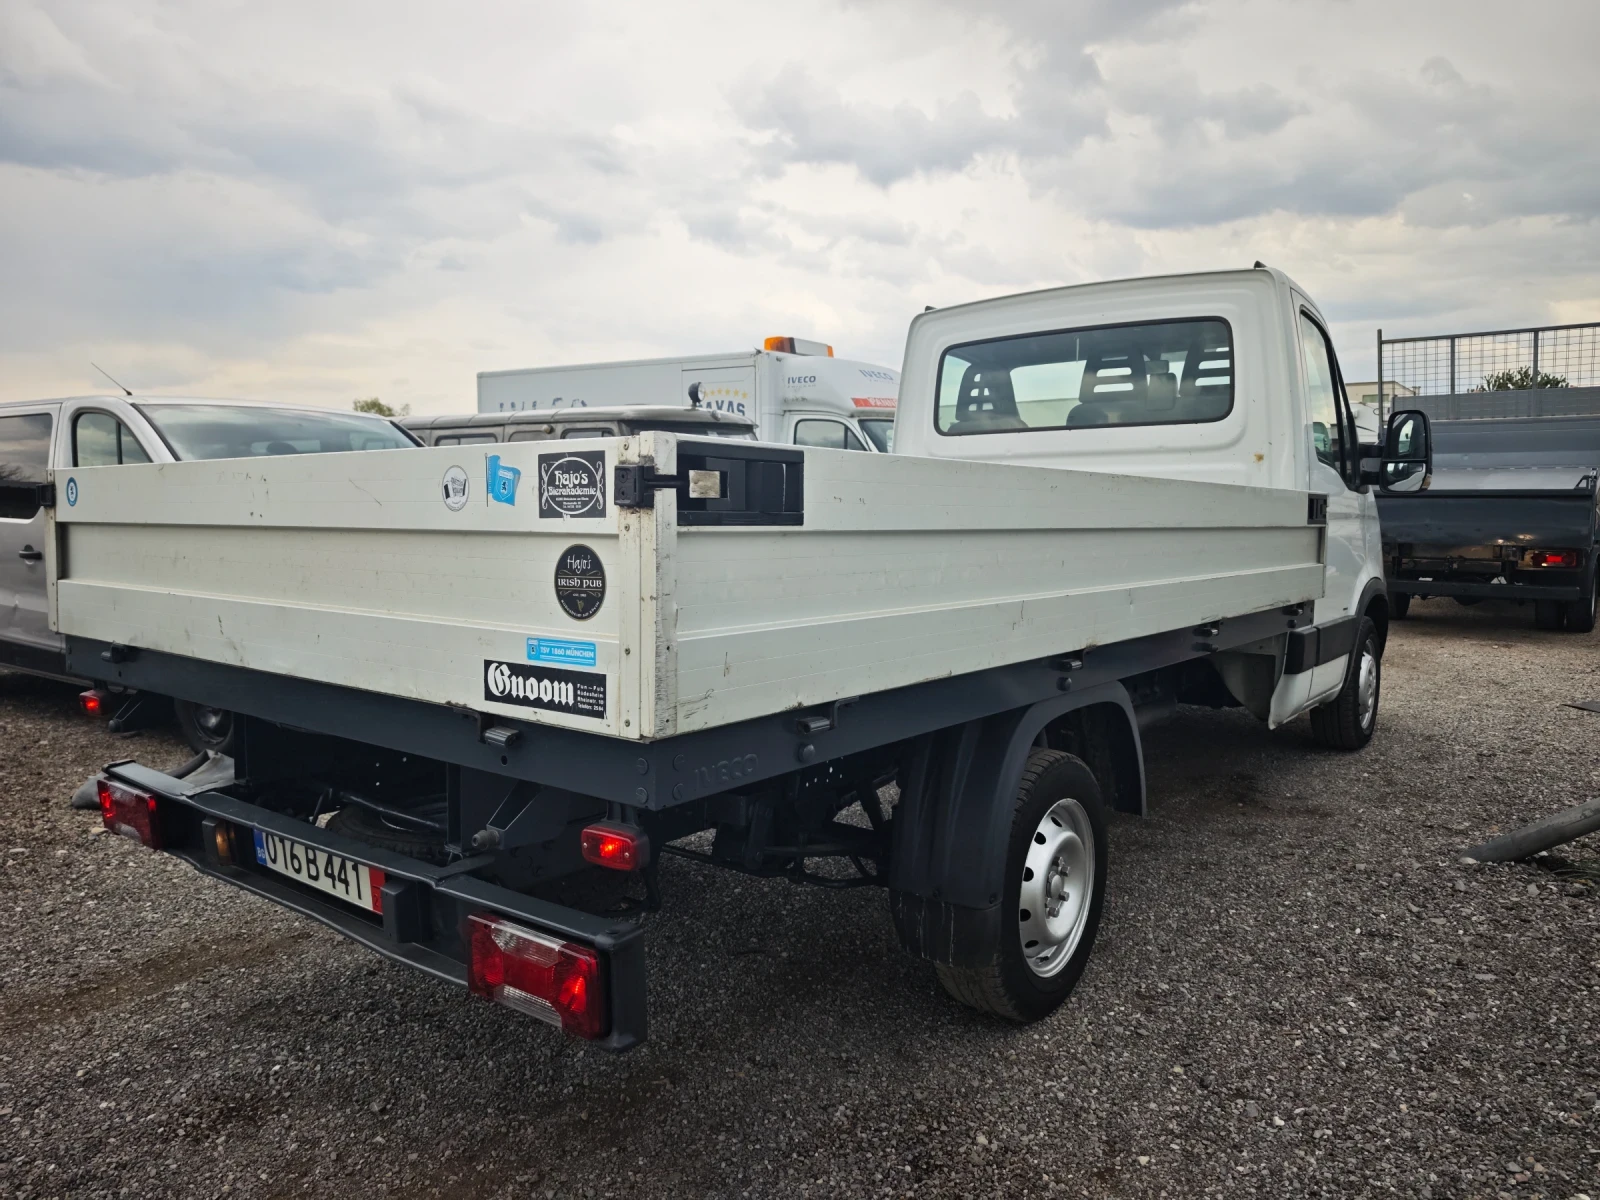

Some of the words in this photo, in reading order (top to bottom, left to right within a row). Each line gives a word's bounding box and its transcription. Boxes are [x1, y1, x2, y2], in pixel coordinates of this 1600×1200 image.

[787, 375, 816, 384] IVECO
[859, 369, 894, 381] IVECO
[567, 554, 591, 574] Hajo's
[566, 648, 594, 658] MÜNCHEN
[487, 662, 574, 706] Gnoom
[695, 753, 758, 791] IVECO
[257, 847, 266, 859] BG
[265, 833, 362, 900] 016B441
